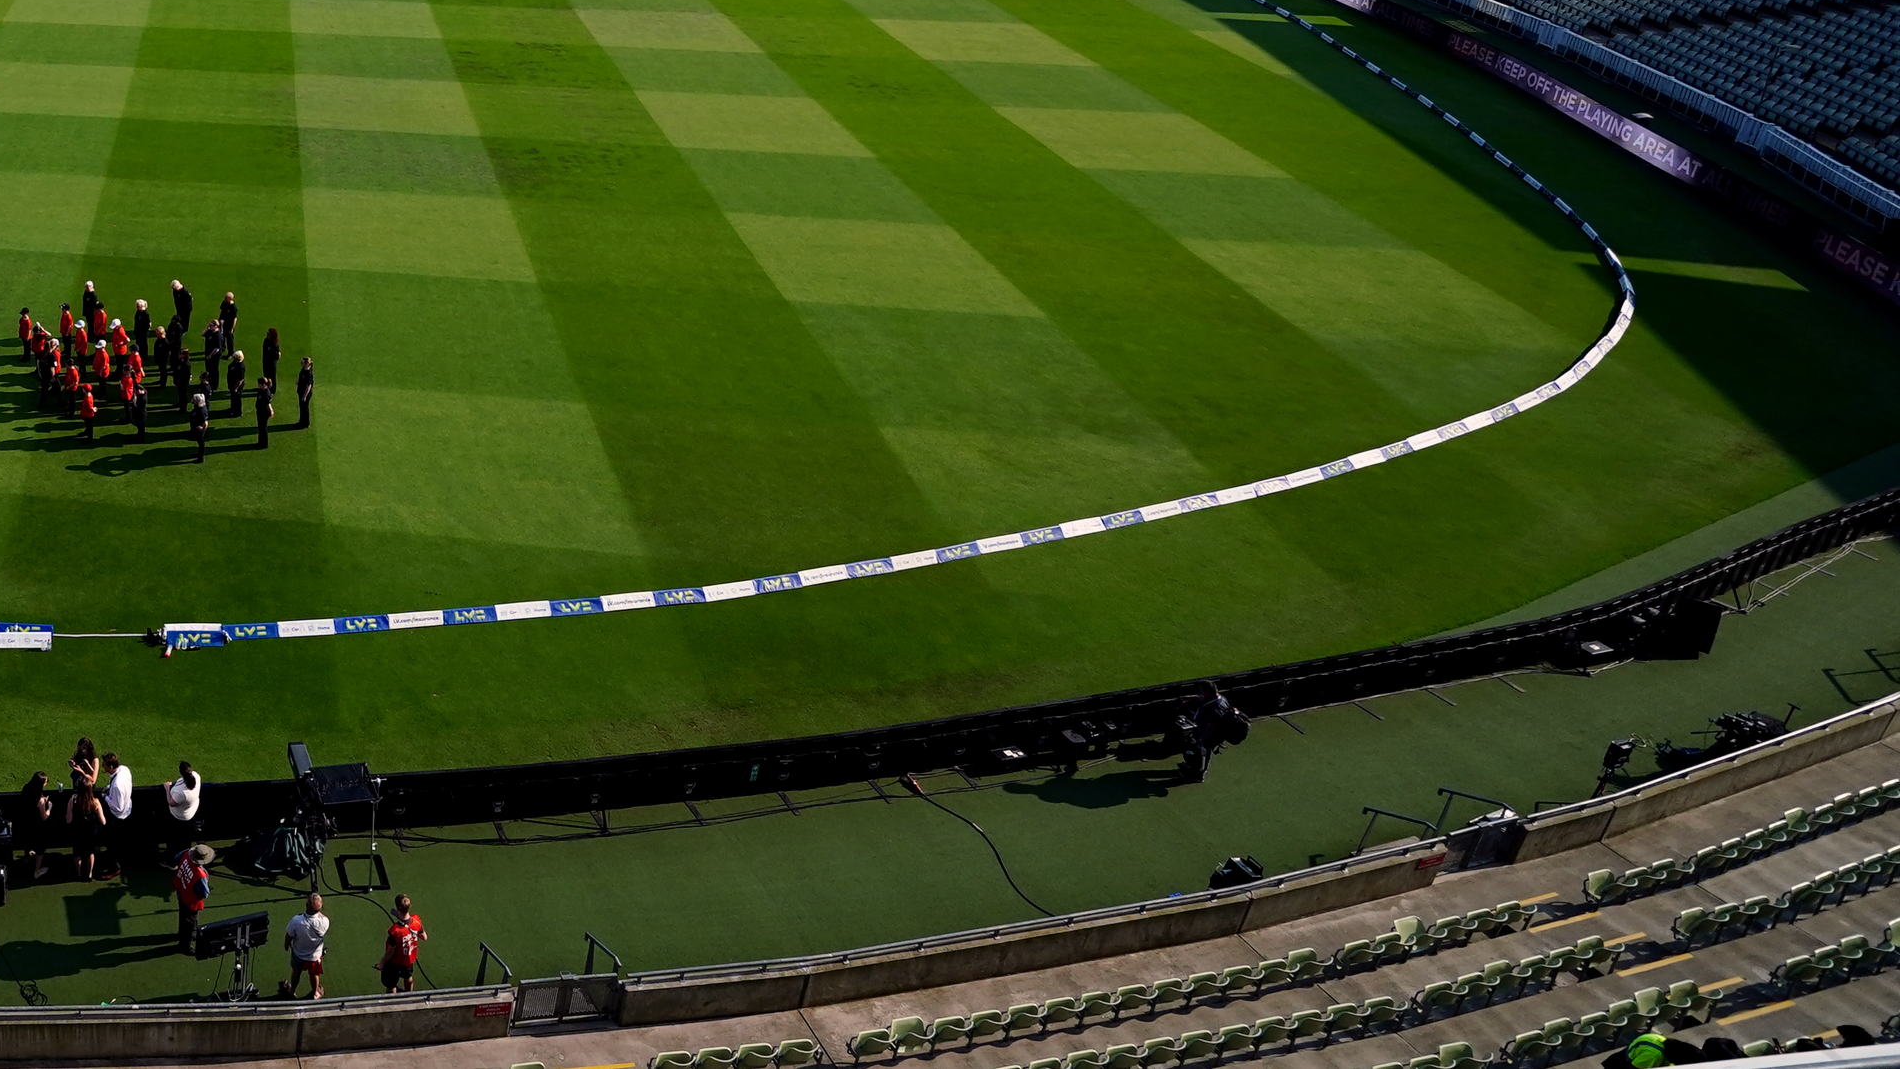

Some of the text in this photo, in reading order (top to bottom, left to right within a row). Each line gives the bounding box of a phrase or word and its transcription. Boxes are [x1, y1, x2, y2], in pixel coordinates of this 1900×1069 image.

[1448, 33, 1493, 68] PLEASE
[1496, 55, 1526, 81] KEEP
[1528, 71, 1552, 95] OFF
[1553, 84, 1577, 111] THE
[1577, 99, 1632, 142] PLAYING
[1633, 131, 1675, 167] AREA
[1676, 155, 1703, 180] AT
[1815, 229, 1888, 283] PLEASE
[393, 615, 439, 625] LV.com/insurance
